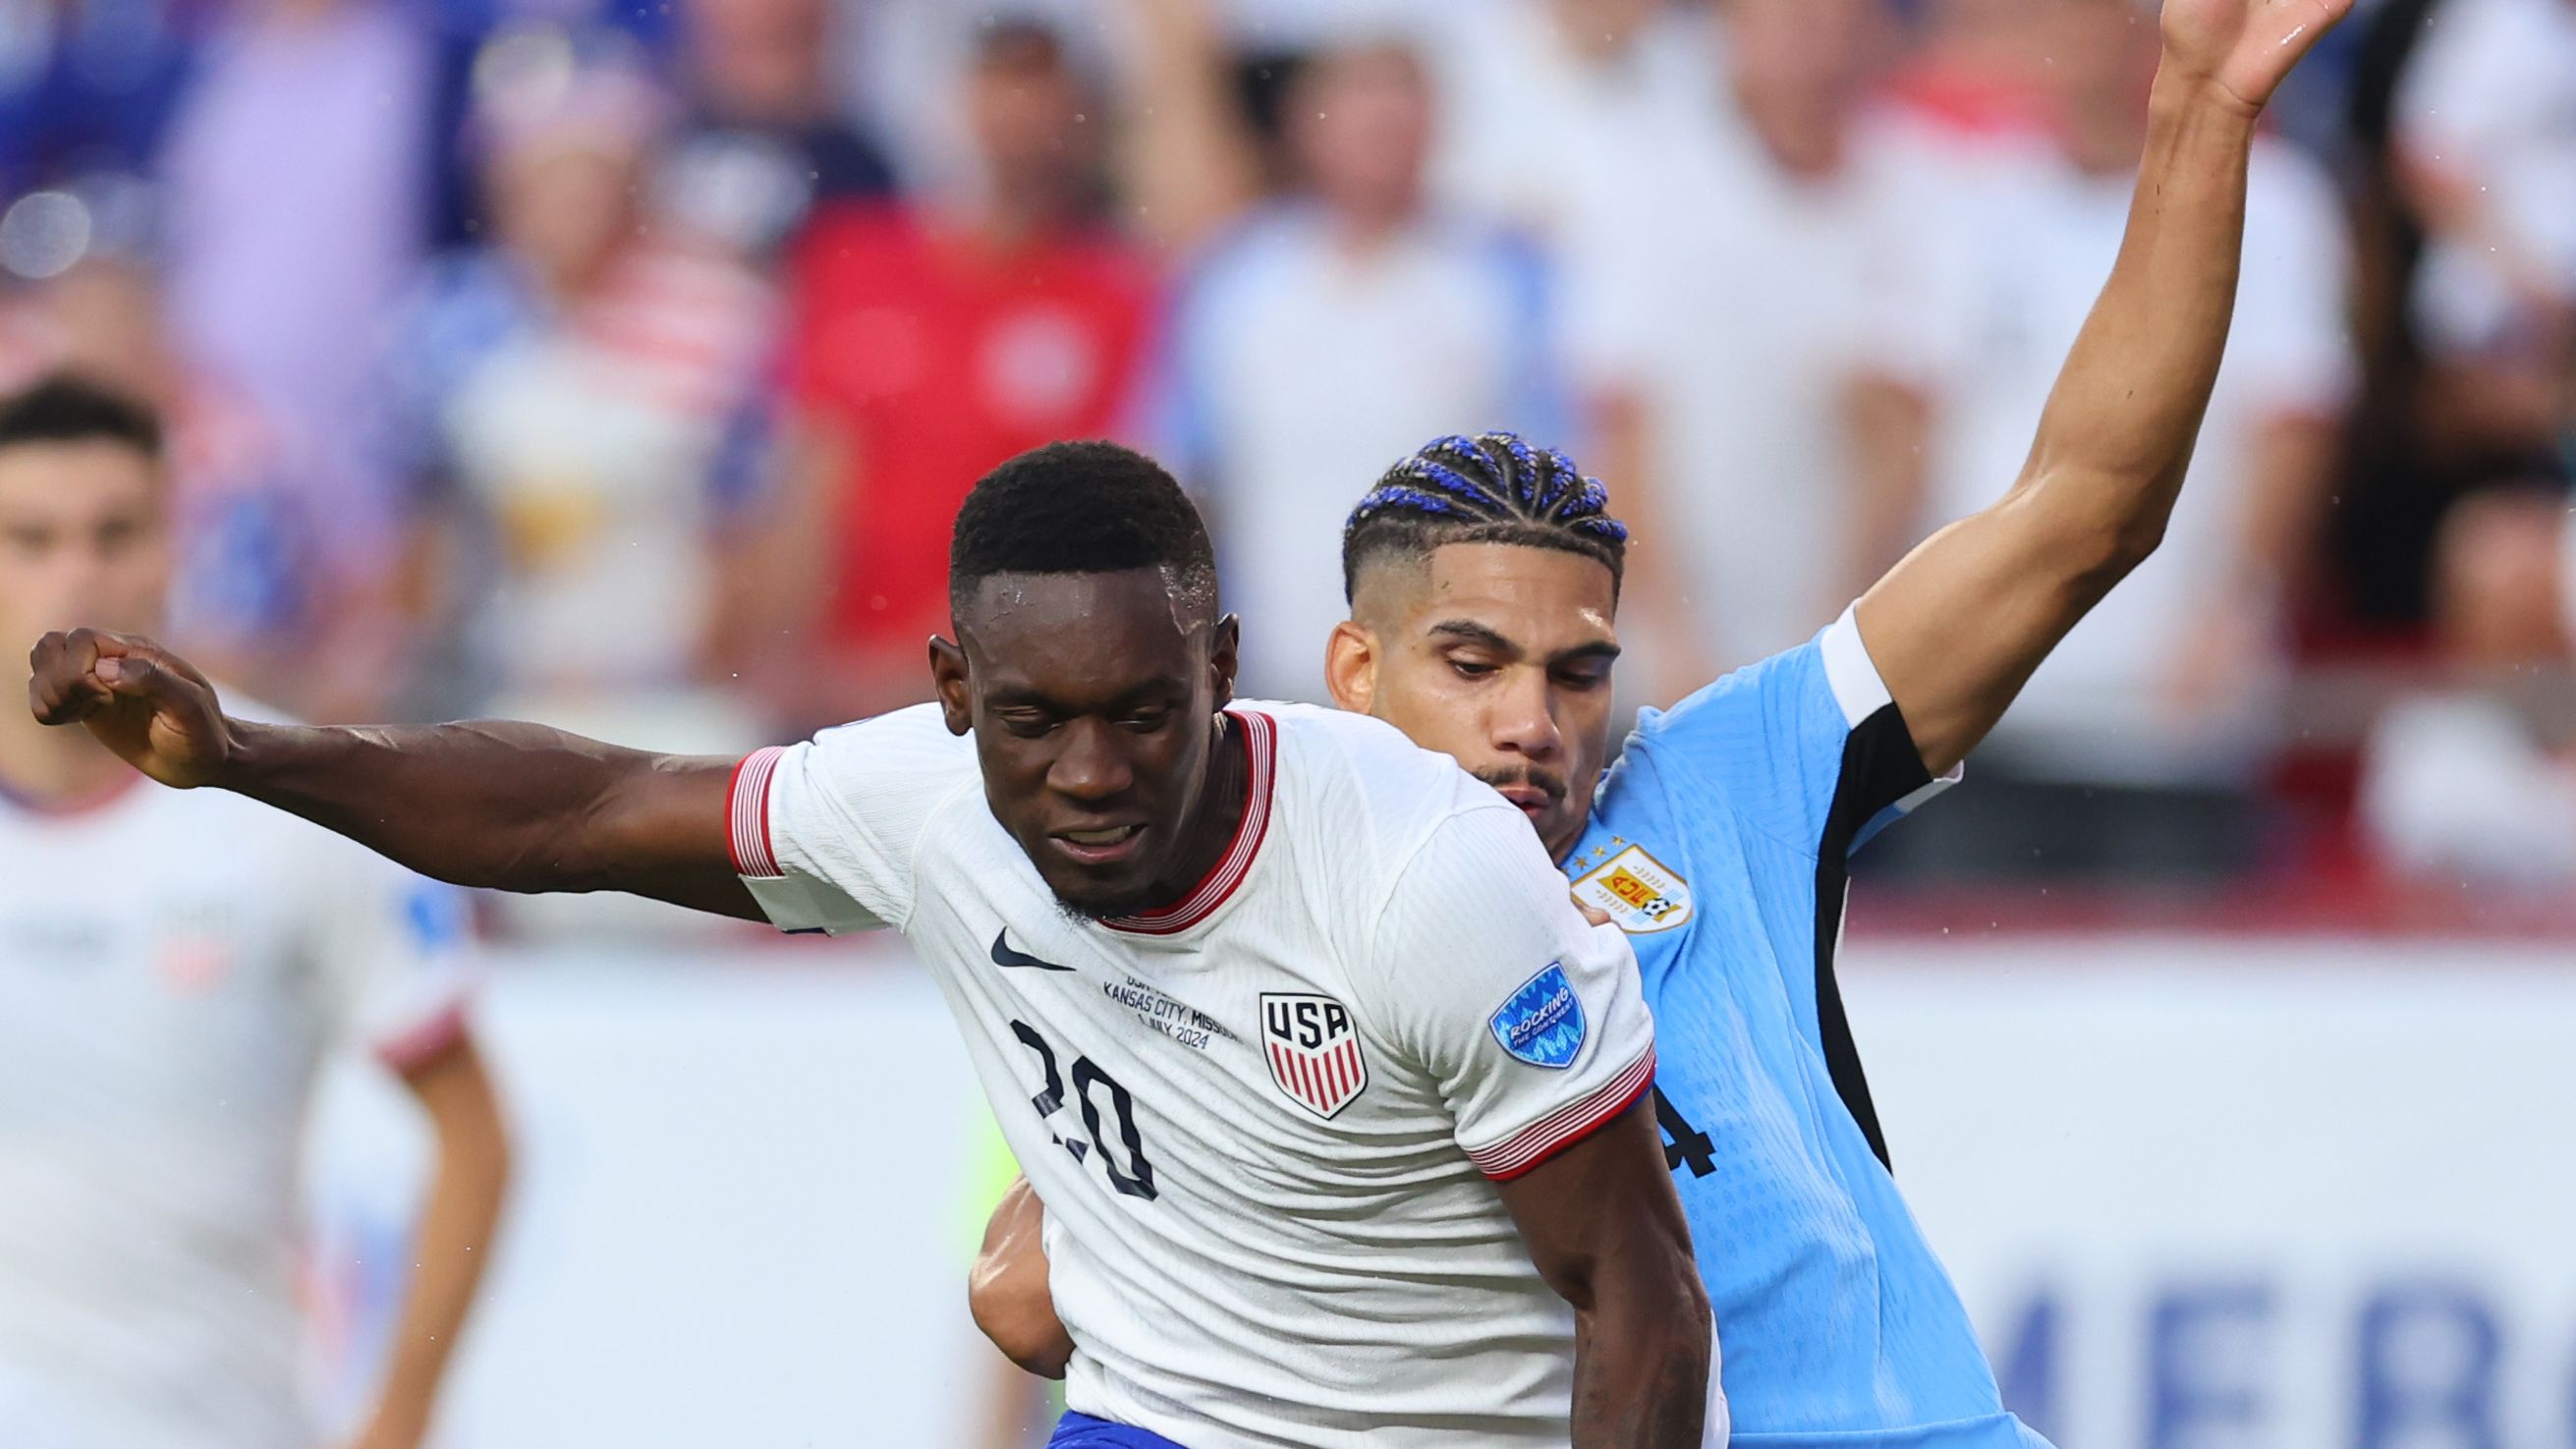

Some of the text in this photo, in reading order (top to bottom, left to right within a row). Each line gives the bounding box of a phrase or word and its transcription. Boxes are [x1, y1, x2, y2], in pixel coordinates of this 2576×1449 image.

[1104, 981, 1153, 1013] KANSAS
[1154, 998, 1186, 1025] CITY,
[1266, 1002, 1349, 1050] USA
[1510, 986, 1569, 1040] ROCKING
[1177, 1026, 1209, 1049] 2024
[1010, 1019, 1159, 1202] 20
[1652, 1082, 1717, 1179] 4
